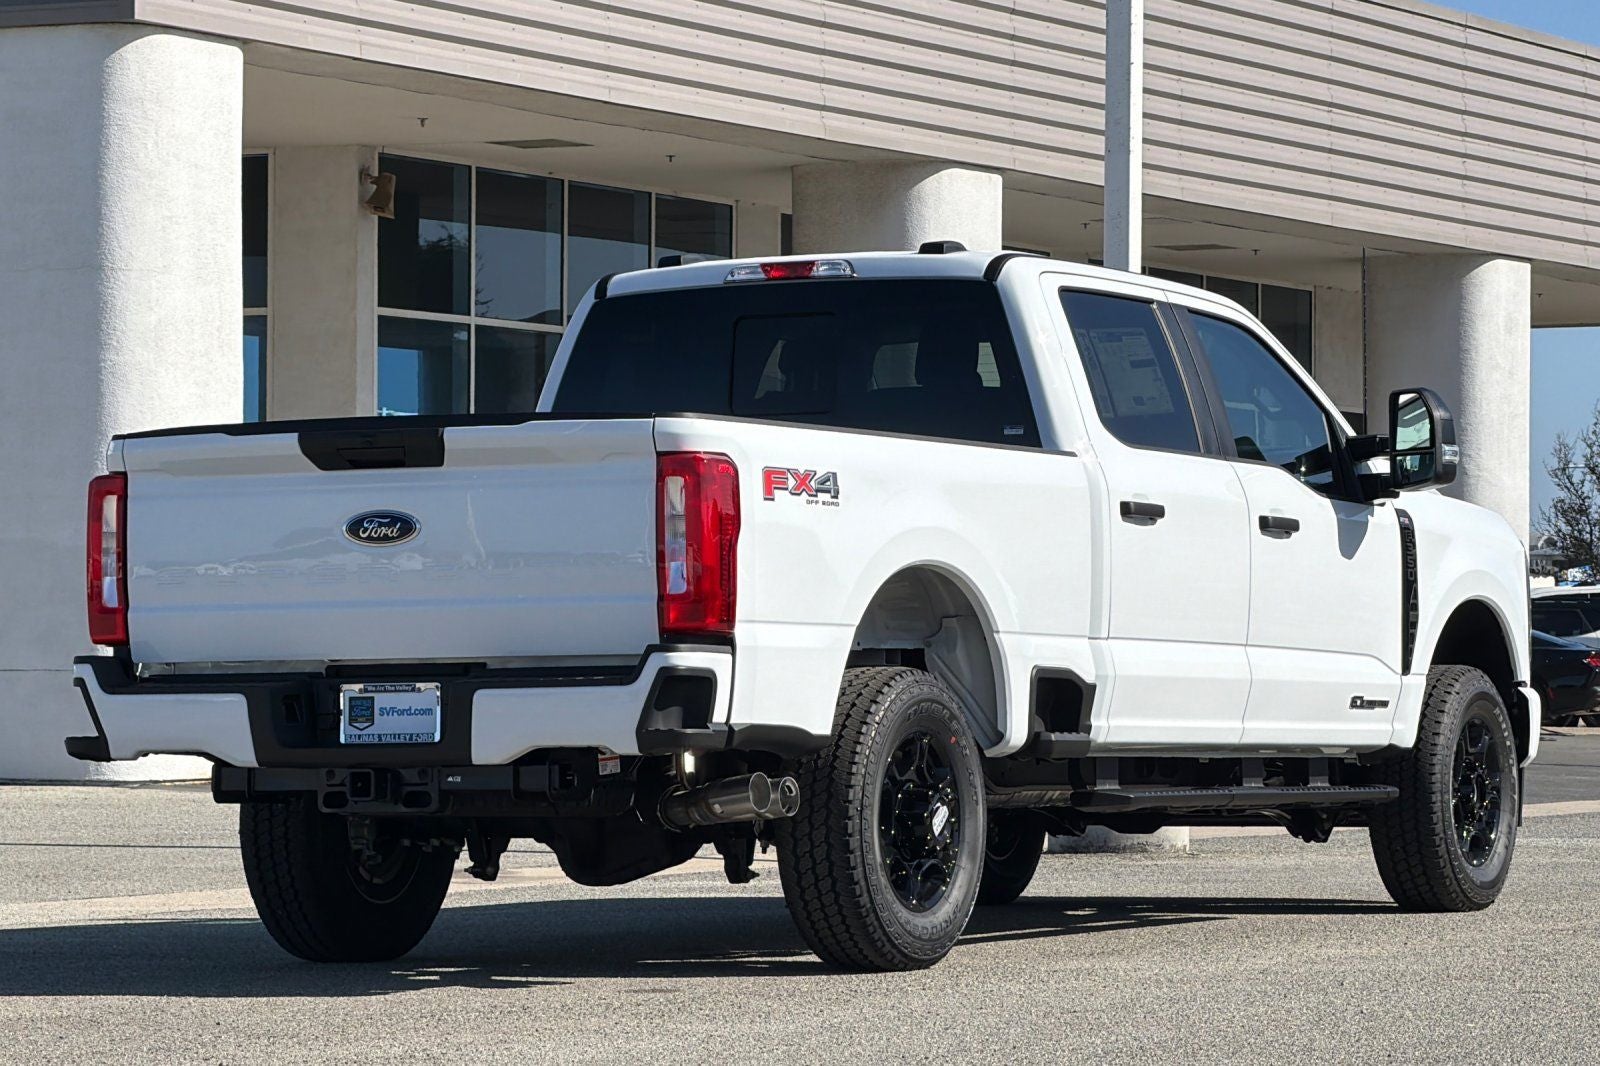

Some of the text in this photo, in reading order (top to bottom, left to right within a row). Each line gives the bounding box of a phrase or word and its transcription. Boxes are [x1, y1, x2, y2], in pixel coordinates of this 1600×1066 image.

[762, 466, 840, 501] FX4
[359, 517, 401, 537] Ford
[378, 706, 433, 717] SVFord.com
[346, 733, 434, 742] SALINAS VALLEY FORD
